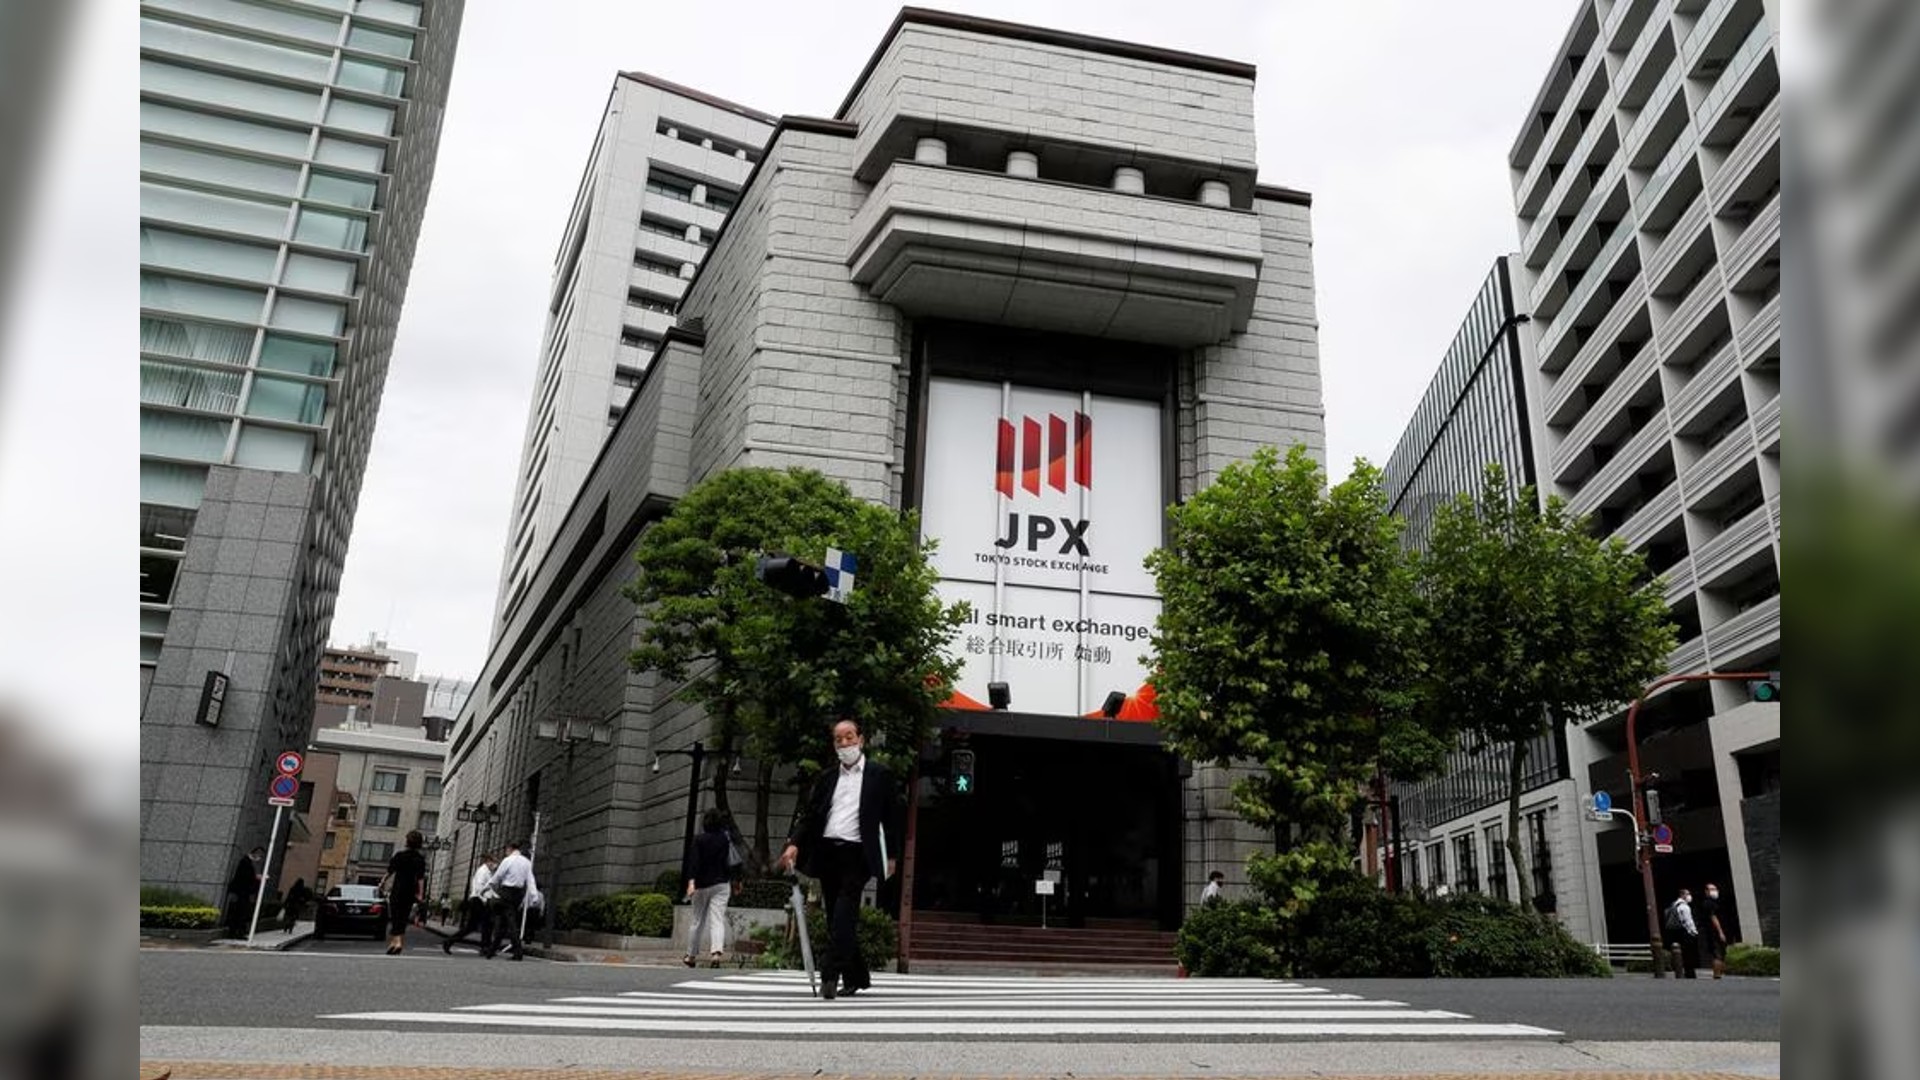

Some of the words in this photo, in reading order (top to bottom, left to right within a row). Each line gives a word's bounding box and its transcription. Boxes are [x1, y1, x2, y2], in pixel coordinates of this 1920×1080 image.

[994, 512, 1090, 557] JPX
[975, 553, 1011, 564] TOKYO
[1013, 557, 1048, 568] STOCK
[1050, 561, 1109, 574] EXCHANGE
[986, 612, 1046, 631] smart
[966, 634, 1064, 660] 総合取引所
